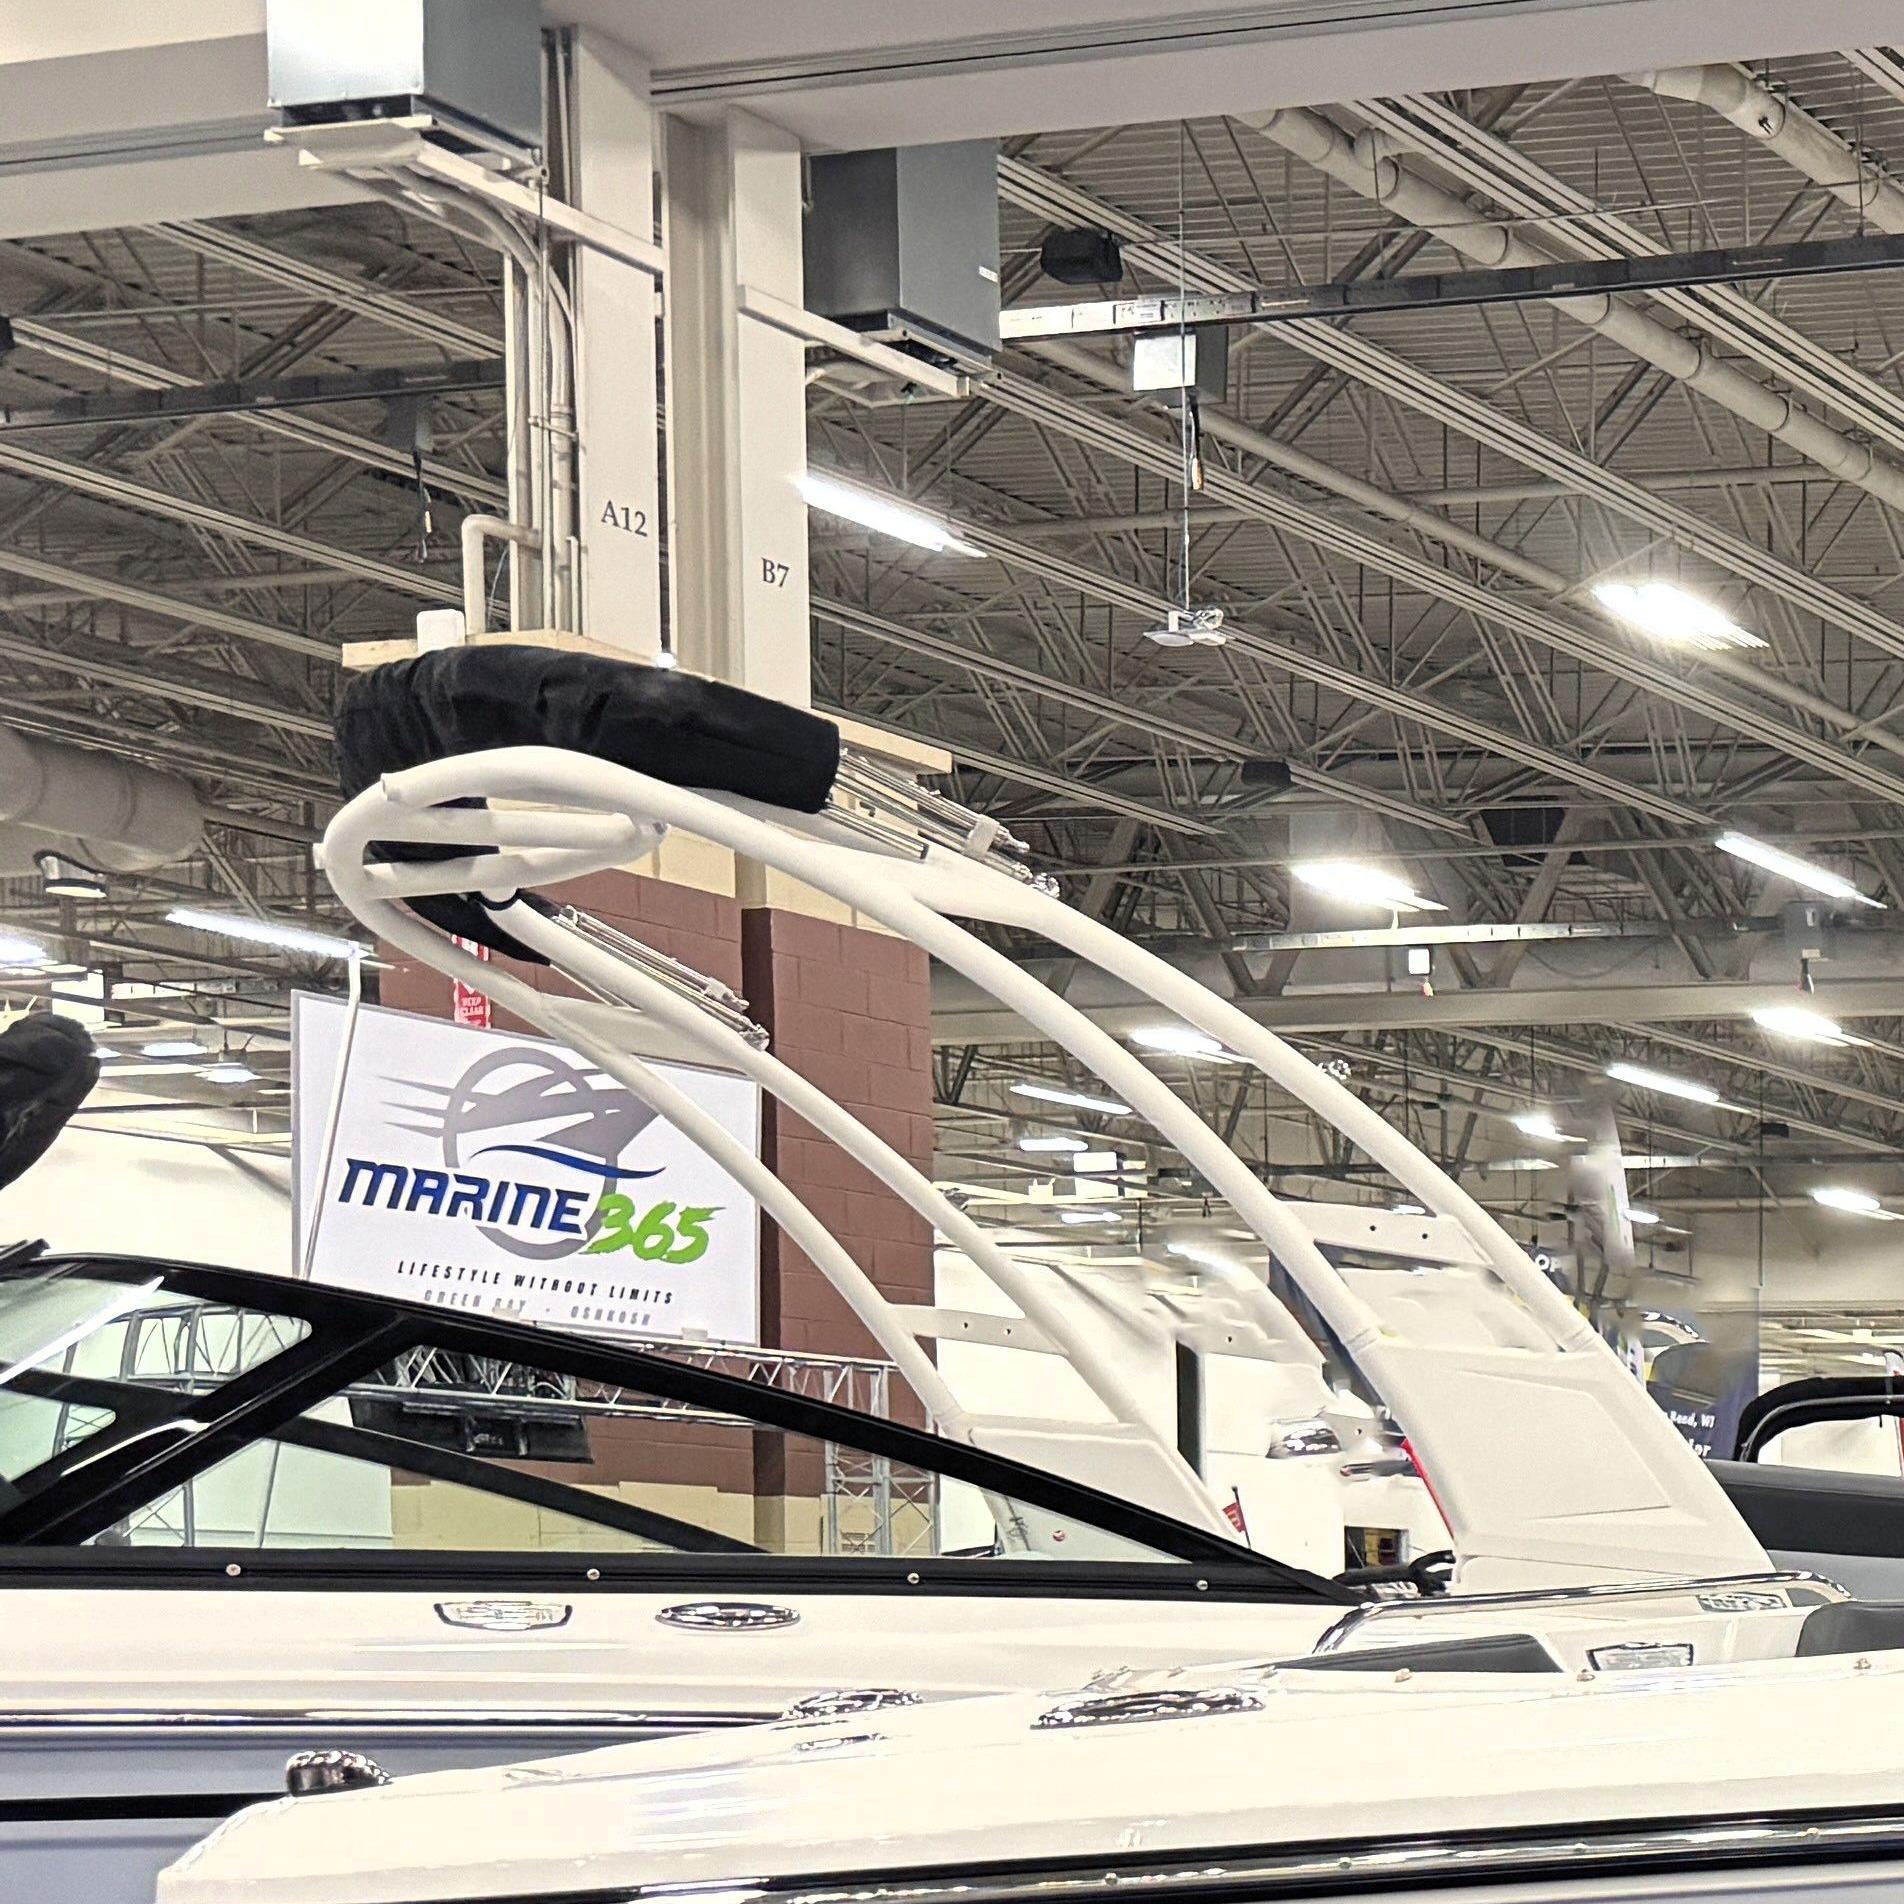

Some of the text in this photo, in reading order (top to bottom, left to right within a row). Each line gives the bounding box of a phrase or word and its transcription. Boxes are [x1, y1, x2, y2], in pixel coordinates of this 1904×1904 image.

[600, 500, 648, 537] A12
[761, 557, 790, 588] B7
[338, 1157, 725, 1265] MARINE 365
[398, 1260, 500, 1285] LIFESTYLE
[608, 1285, 673, 1304] LIMITS
